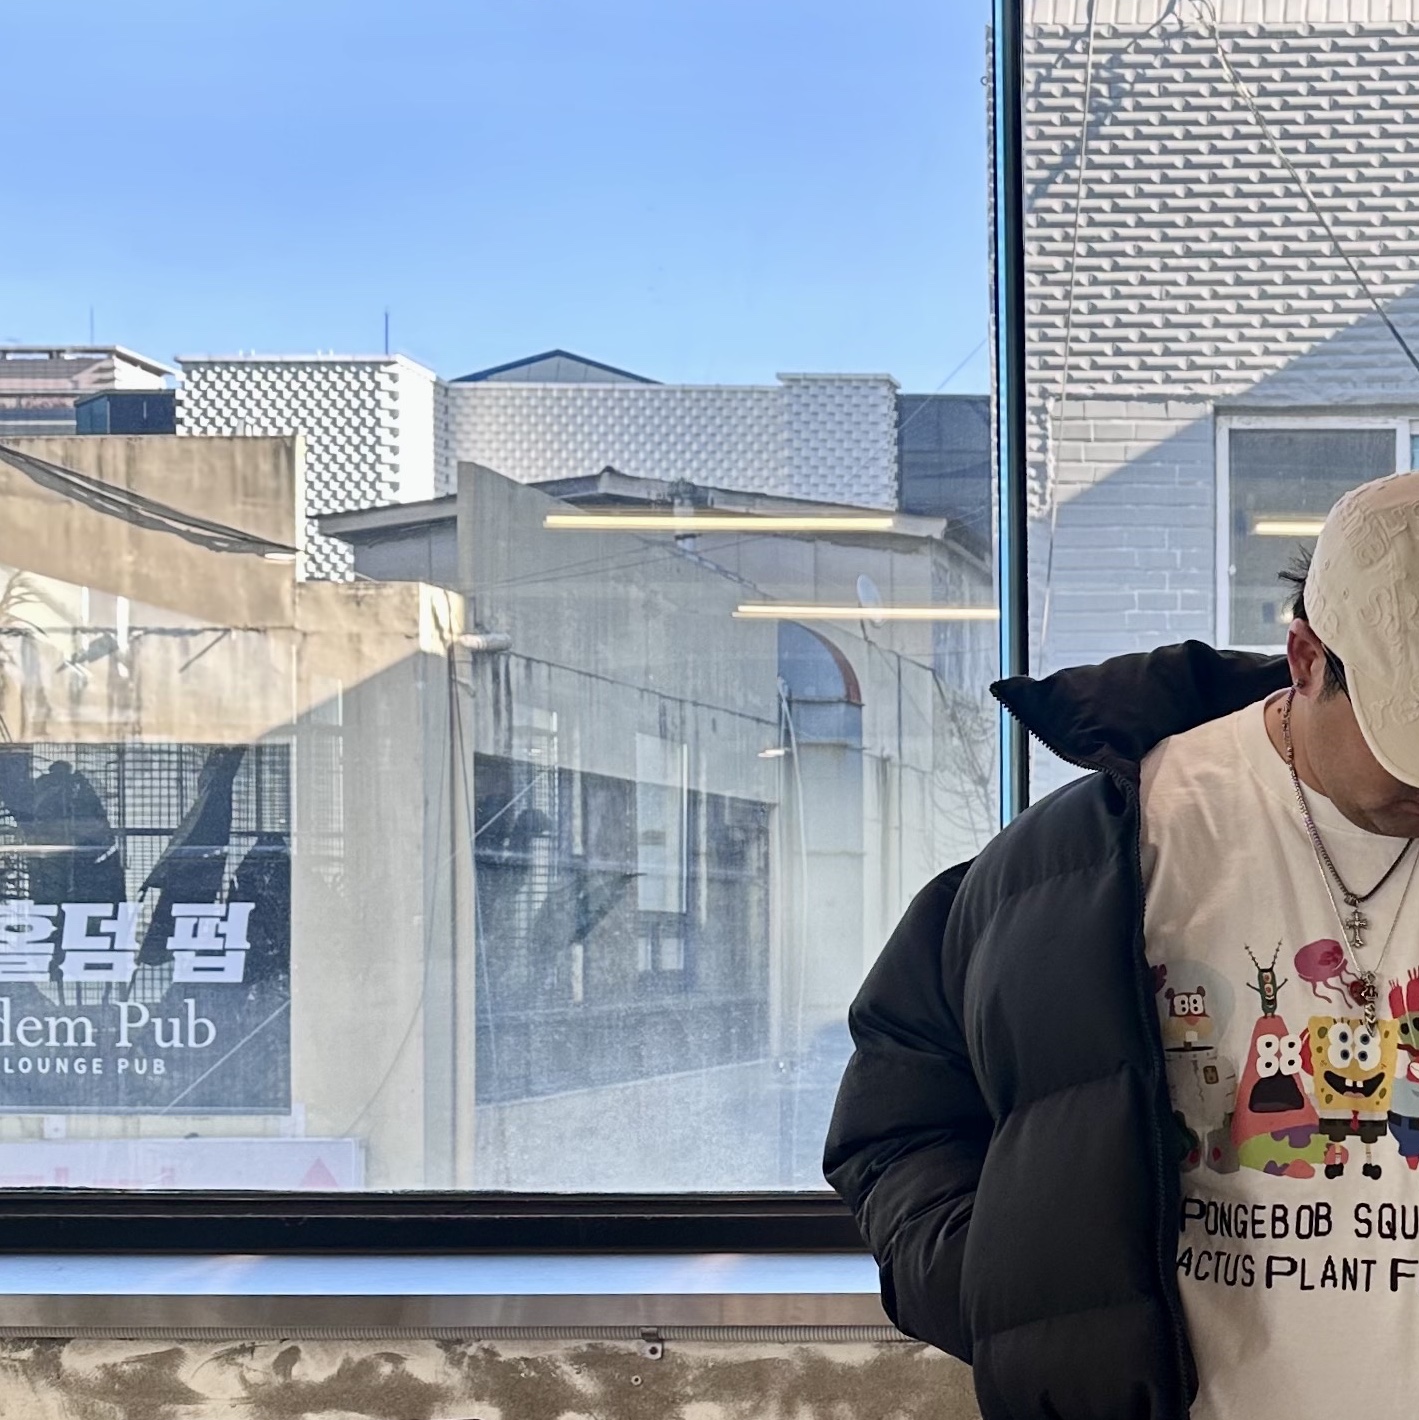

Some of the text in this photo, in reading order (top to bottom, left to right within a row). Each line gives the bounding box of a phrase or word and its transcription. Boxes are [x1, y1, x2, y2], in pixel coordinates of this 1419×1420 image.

[166, 902, 256, 983] 펍
[113, 999, 217, 1048] Pub
[4, 1057, 165, 1074] LOUNGE PUB
[1265, 1255, 1377, 1292] PLANT
